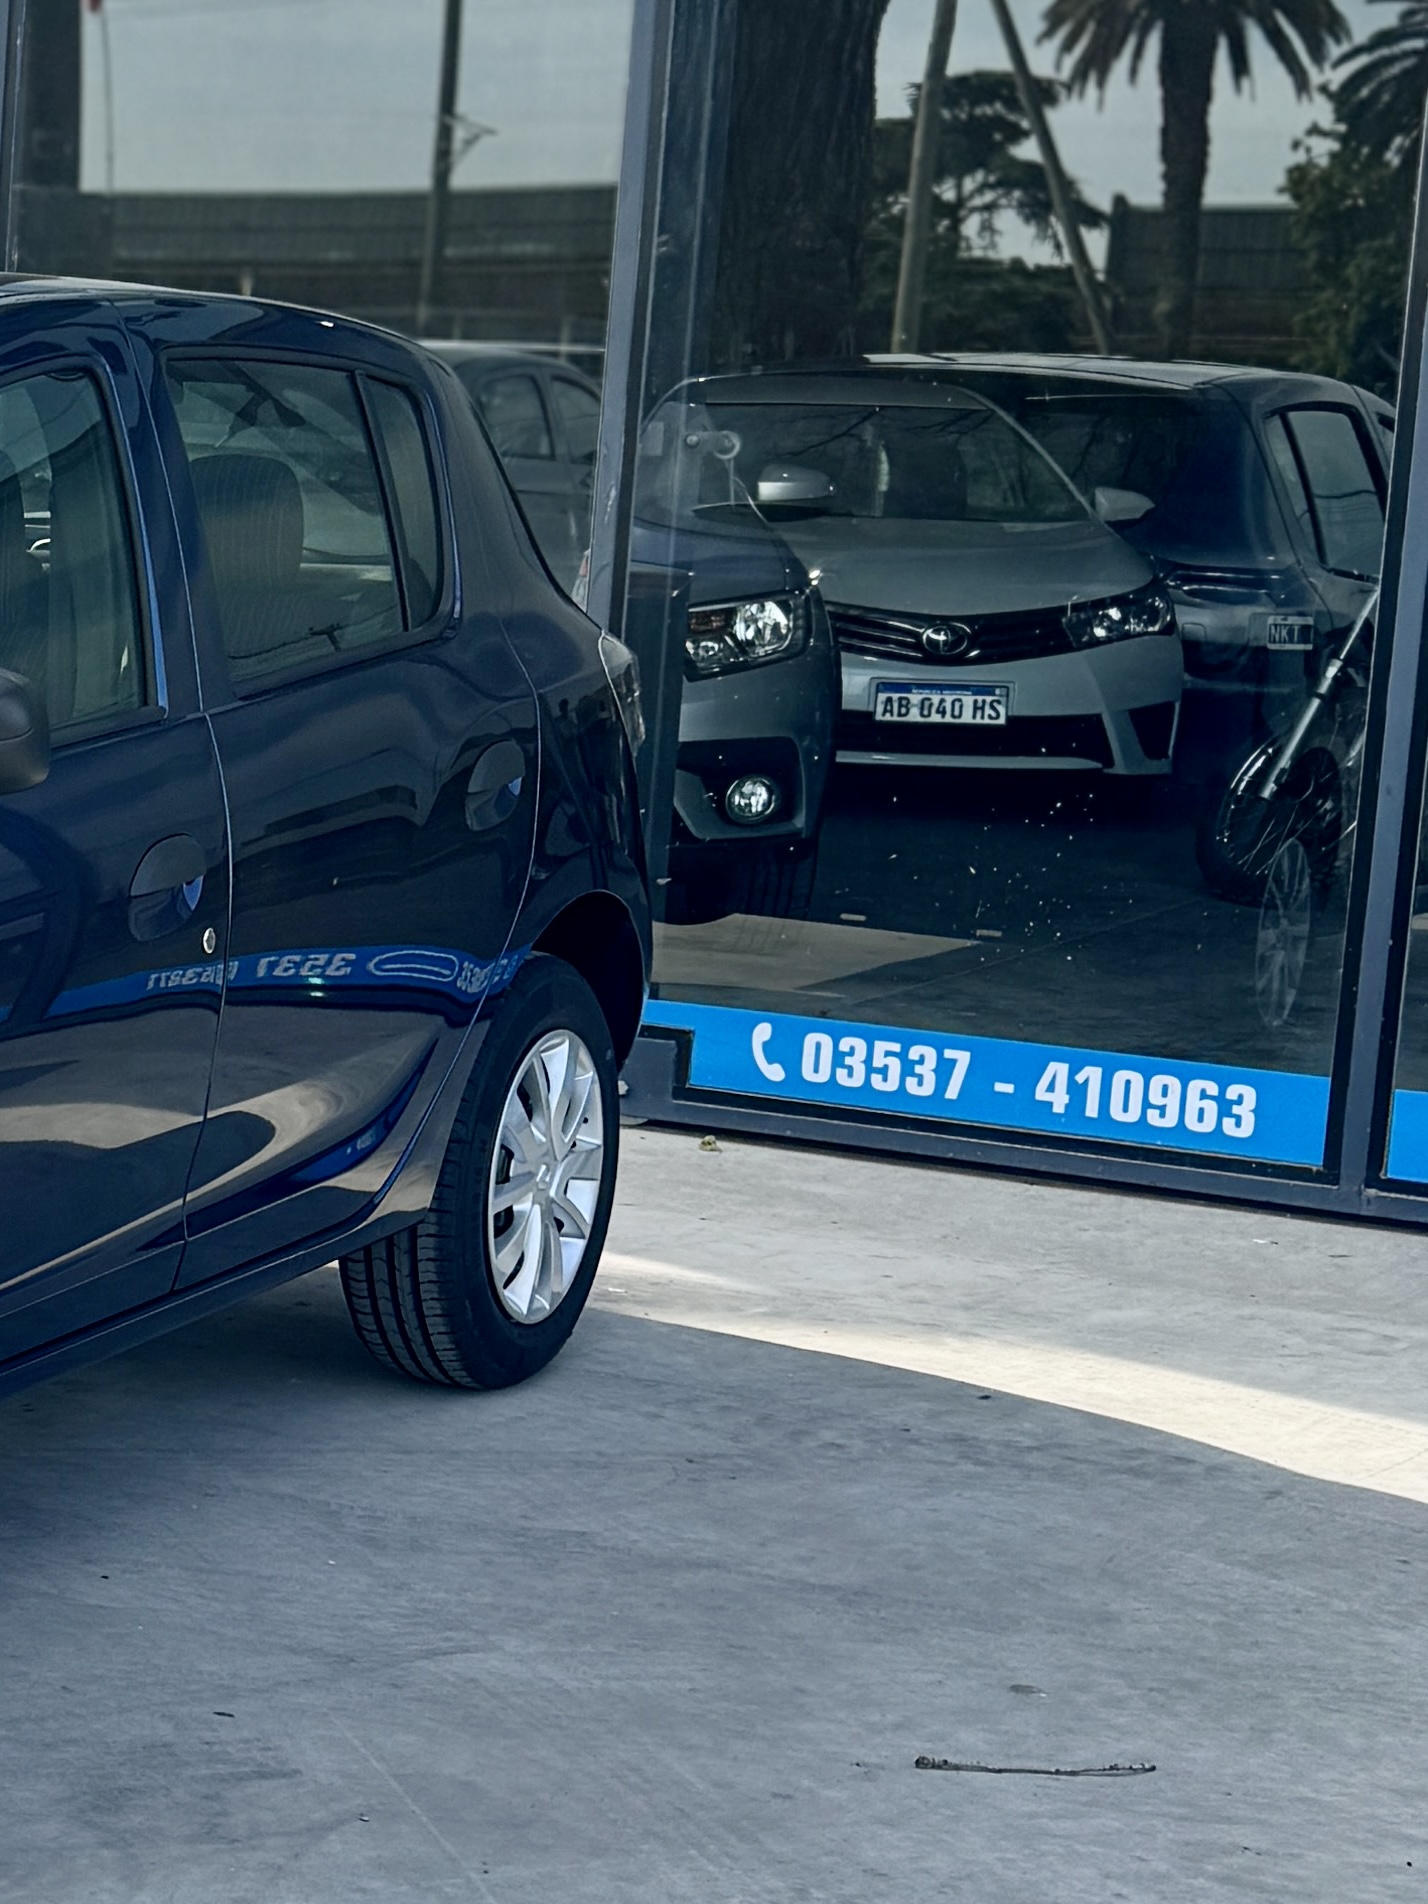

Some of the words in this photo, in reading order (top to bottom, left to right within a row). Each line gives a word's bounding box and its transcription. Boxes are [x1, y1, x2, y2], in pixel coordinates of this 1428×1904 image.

[881, 695, 911, 718] AB
[919, 696, 964, 720] 040
[972, 698, 1003, 721] HS
[801, 1032, 971, 1100] 03537
[1034, 1061, 1257, 1138] 410963
